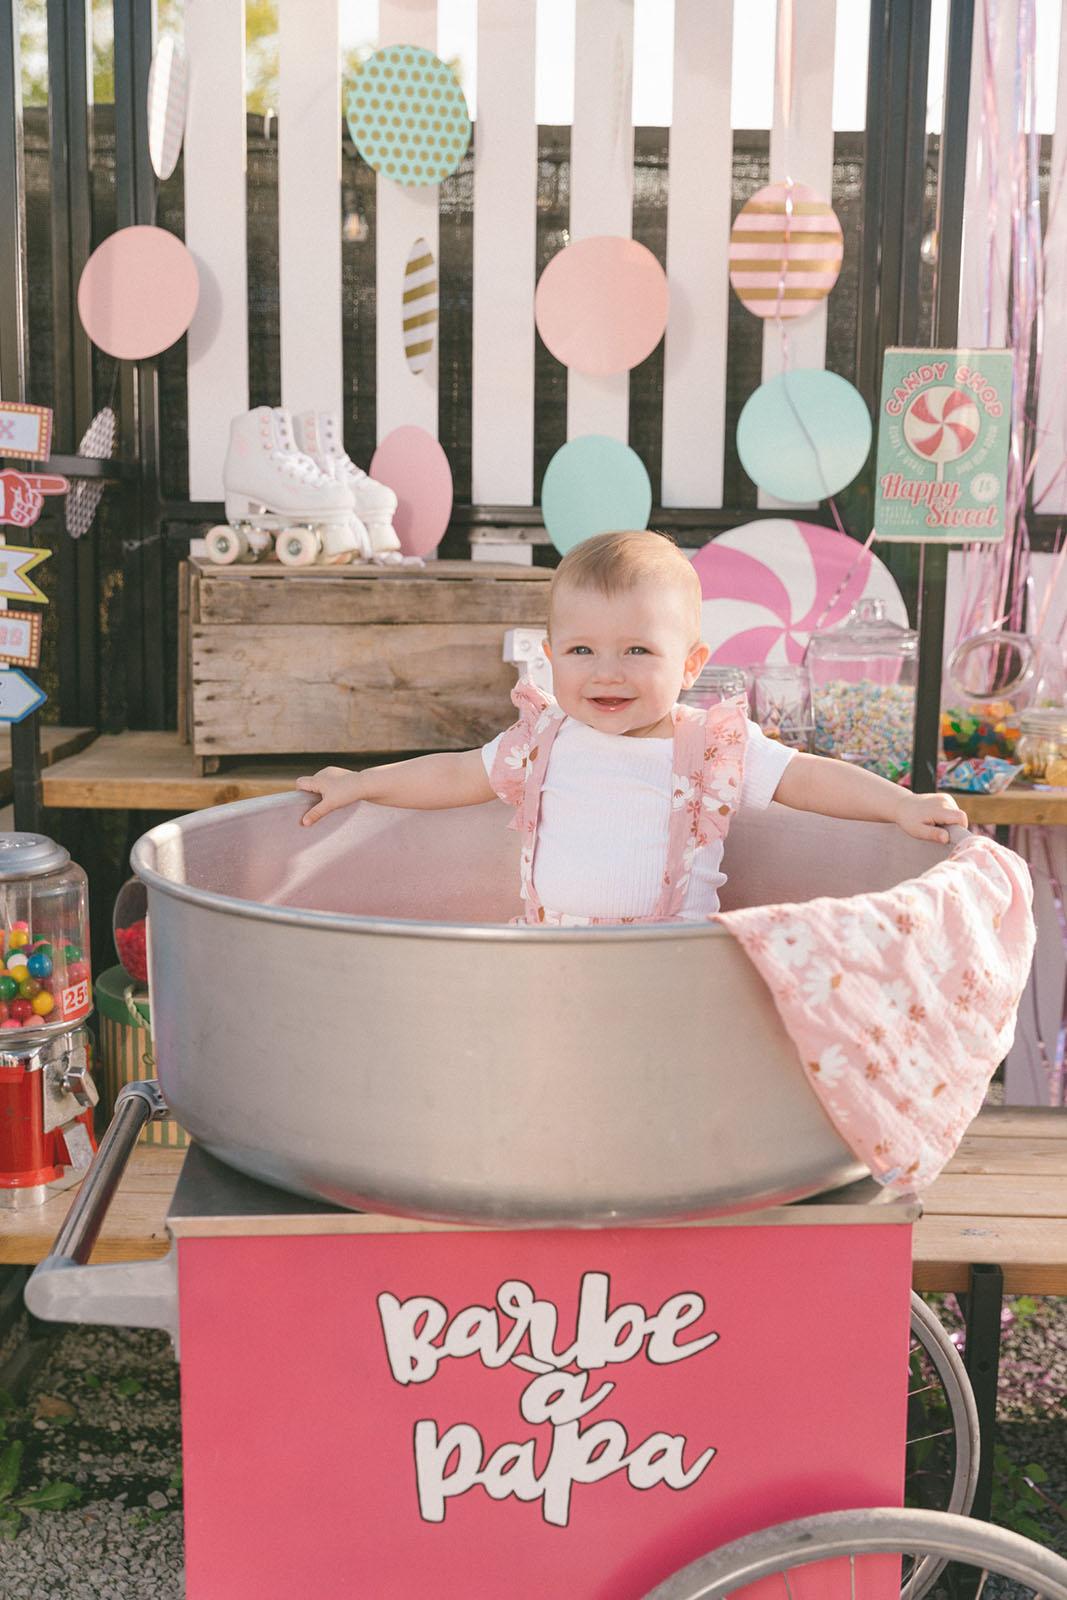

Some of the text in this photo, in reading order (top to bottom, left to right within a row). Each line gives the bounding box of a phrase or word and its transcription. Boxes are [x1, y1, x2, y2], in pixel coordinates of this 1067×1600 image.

[886, 361, 1003, 417] CANDY SHOP
[881, 473, 960, 507] Happy
[925, 503, 998, 528] Sweet
[377, 1271, 720, 1386] Barbe
[510, 1353, 616, 1427] à
